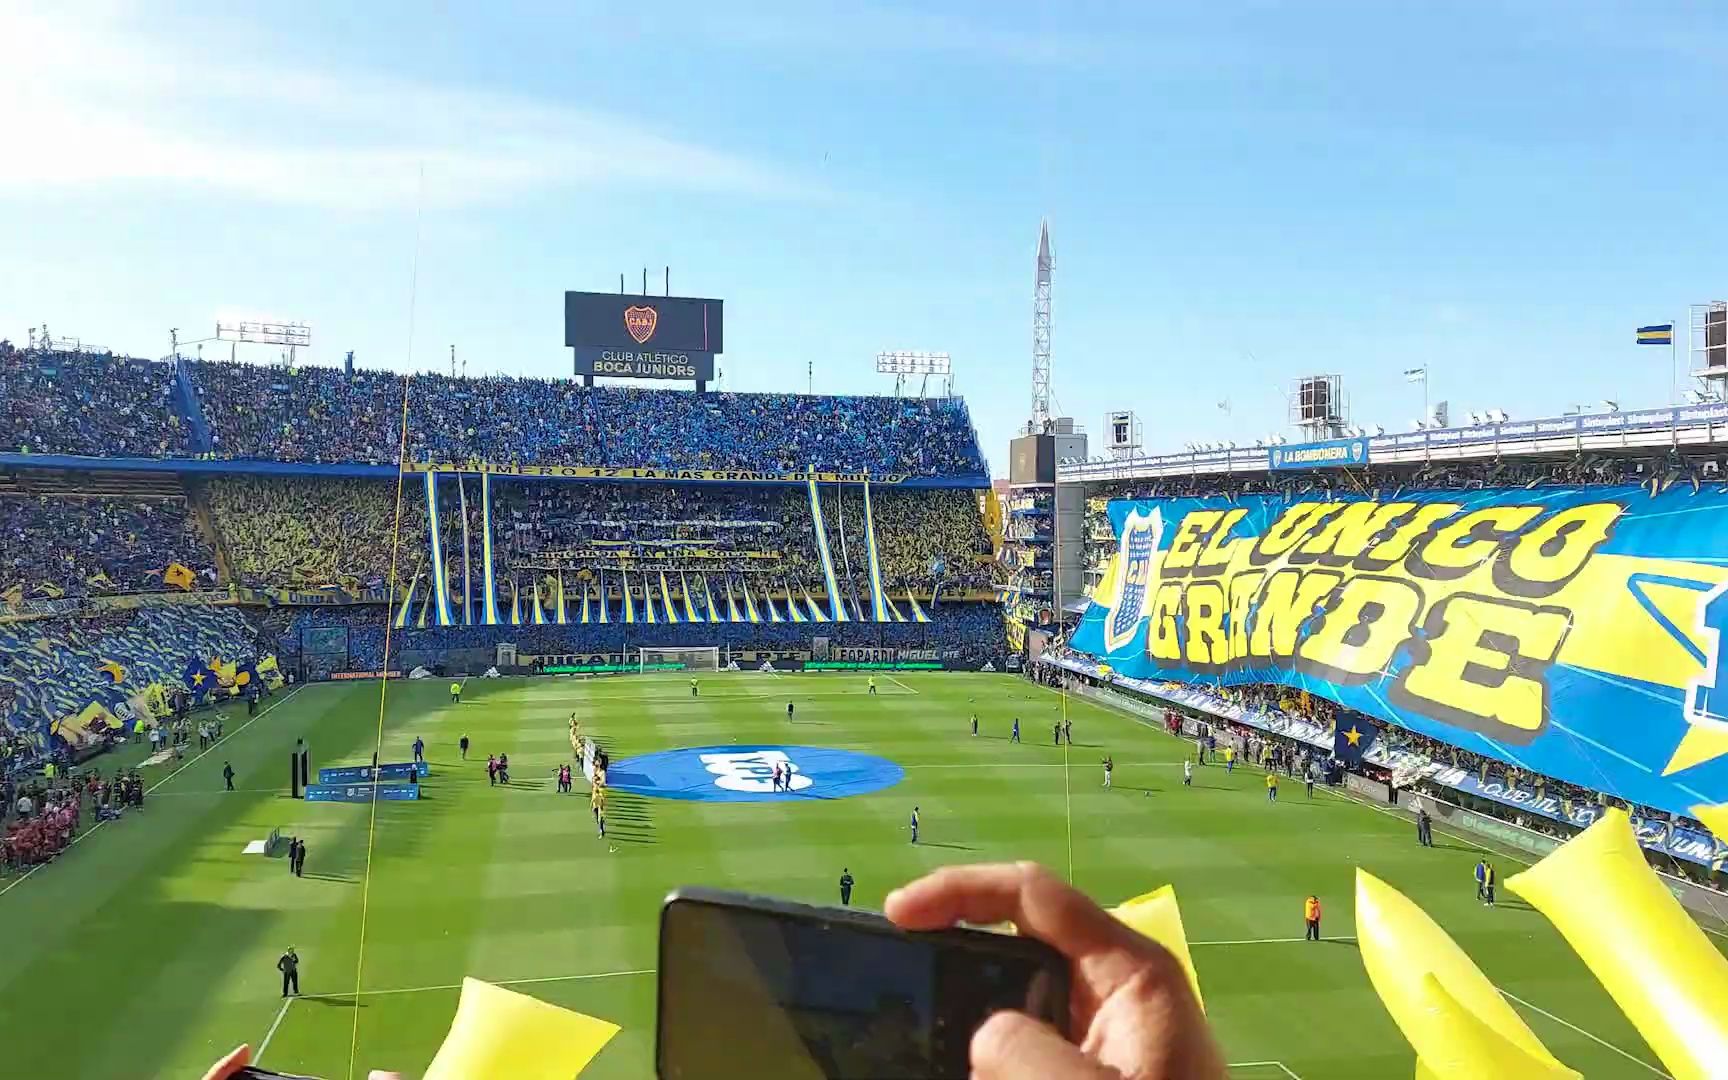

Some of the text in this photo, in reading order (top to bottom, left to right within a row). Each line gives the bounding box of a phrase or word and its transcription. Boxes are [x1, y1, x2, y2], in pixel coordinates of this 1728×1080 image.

[602, 350, 633, 362] CLUB
[593, 361, 696, 376] BOCA JUNIORS
[1284, 448, 1348, 463] LA BOMBONERA
[589, 468, 618, 478] 12
[632, 469, 657, 478] LA
[664, 470, 702, 480] MAS
[712, 471, 788, 481] GRANDE
[794, 472, 826, 481] DEL
[1163, 501, 1623, 584] EL UNICO
[833, 649, 894, 662] LEOPARDI
[896, 650, 938, 661] MIGUEL
[1150, 570, 1570, 731] GRANDE
[1484, 782, 1530, 804] CLUB
